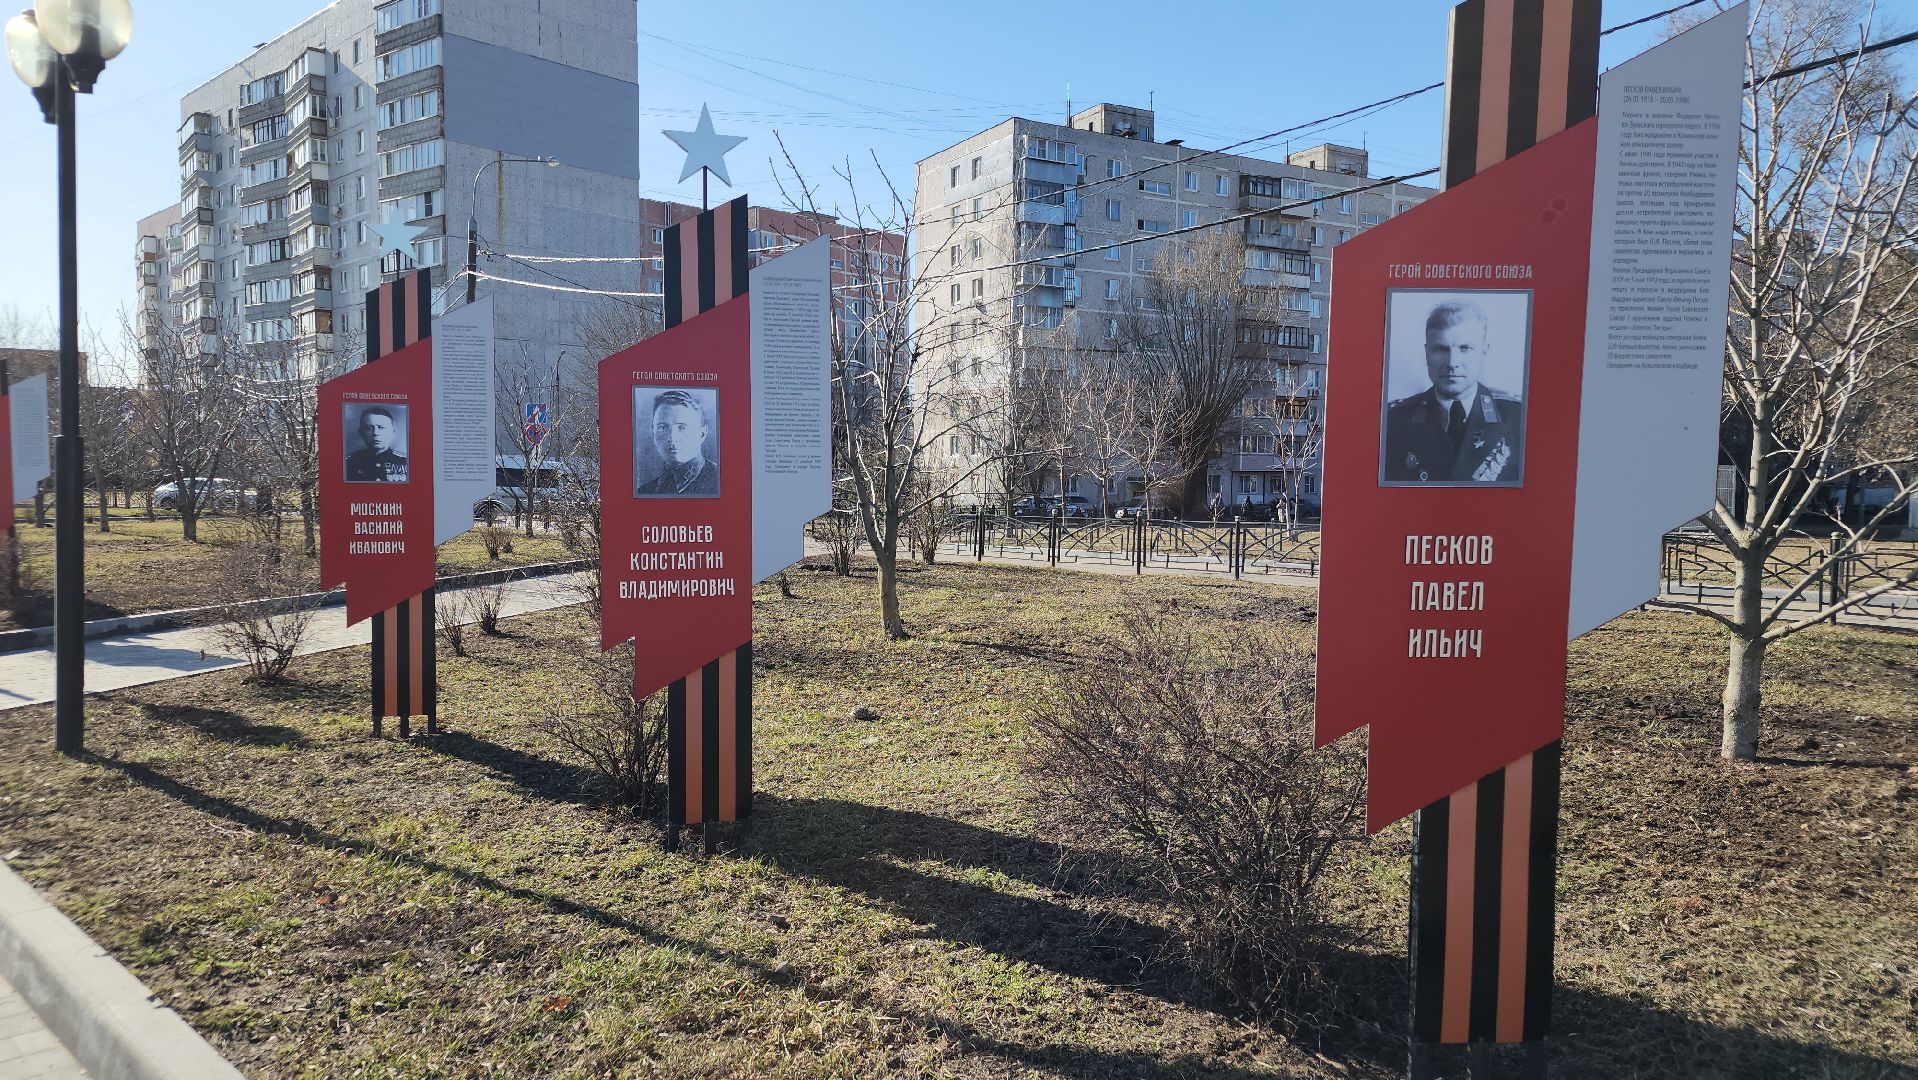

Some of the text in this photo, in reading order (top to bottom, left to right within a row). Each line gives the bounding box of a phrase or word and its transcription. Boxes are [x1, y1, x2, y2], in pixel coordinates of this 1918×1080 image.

[1389, 262, 1533, 279] ГЕРОЙ СОВЕТСКОГО СОЮЗА
[351, 502, 402, 516] МОСКВИН
[354, 520, 403, 535] ВАСИЛИЙ
[641, 525, 713, 544] СОЛОВЬЕВ
[349, 541, 405, 555] ИВАНОВИЧ
[1405, 535, 1493, 565] ПЕСКОВ
[630, 551, 724, 571] КОНСТАНТИН
[619, 578, 735, 600] ВЛАДИМИРОВИЧ
[1410, 581, 1484, 611] ПАВЕЛ
[1408, 628, 1482, 658] ИЛЬИЧ
